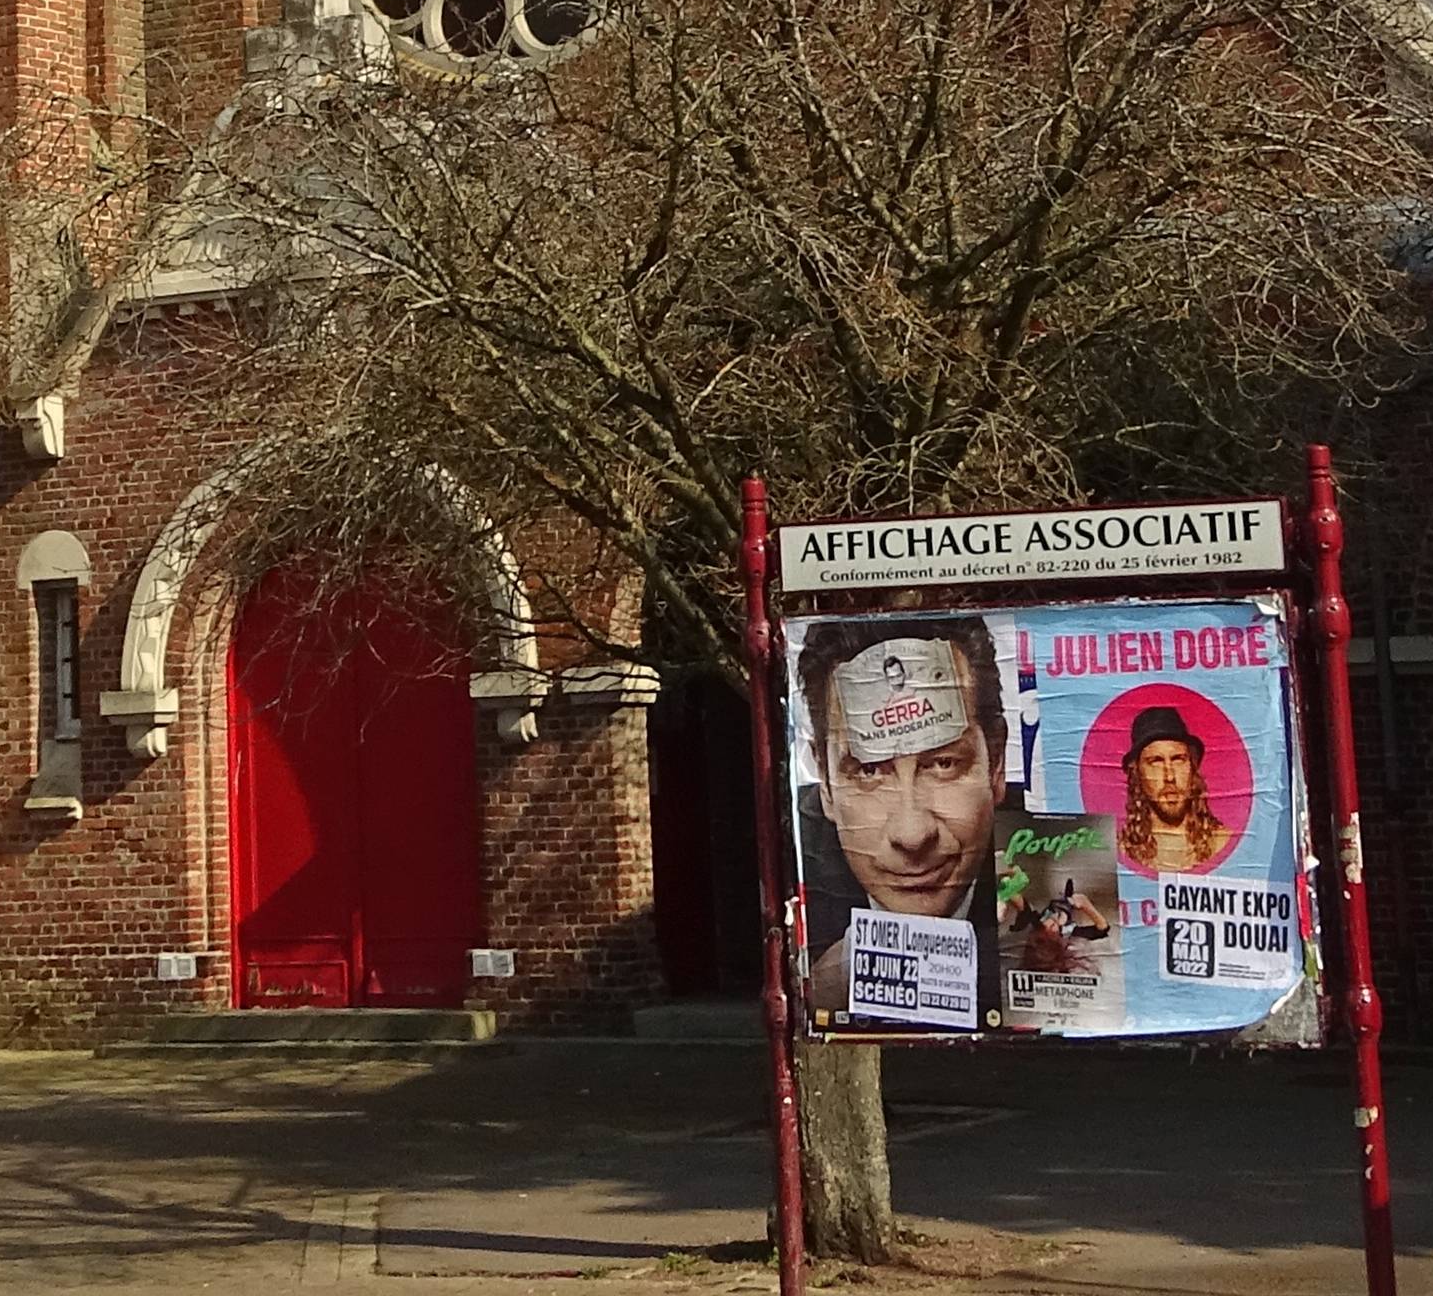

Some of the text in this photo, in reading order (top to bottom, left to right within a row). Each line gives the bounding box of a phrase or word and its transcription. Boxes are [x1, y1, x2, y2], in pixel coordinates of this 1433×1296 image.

[801, 509, 1260, 562] AFFICHAGE ASSOCIATIF
[820, 551, 1243, 582] Conformément au décret n° 82-220 du 25 février 1982
[1045, 613, 1270, 678] JULIEN DORÉ
[870, 698, 936, 728] GERRA
[860, 725, 886, 743] SANS
[1164, 883, 1238, 916] GAYANT
[1242, 890, 1291, 921] EXPO
[855, 917, 869, 945] ST
[871, 919, 901, 950] OMER
[1174, 919, 1207, 945] 20
[1223, 921, 1289, 953] DOUAI
[855, 952, 918, 983] 03 JUIN 22
[1172, 942, 1209, 963] MAI
[1173, 960, 1207, 977] 2022
[854, 980, 916, 1006] SCÉNÉO
